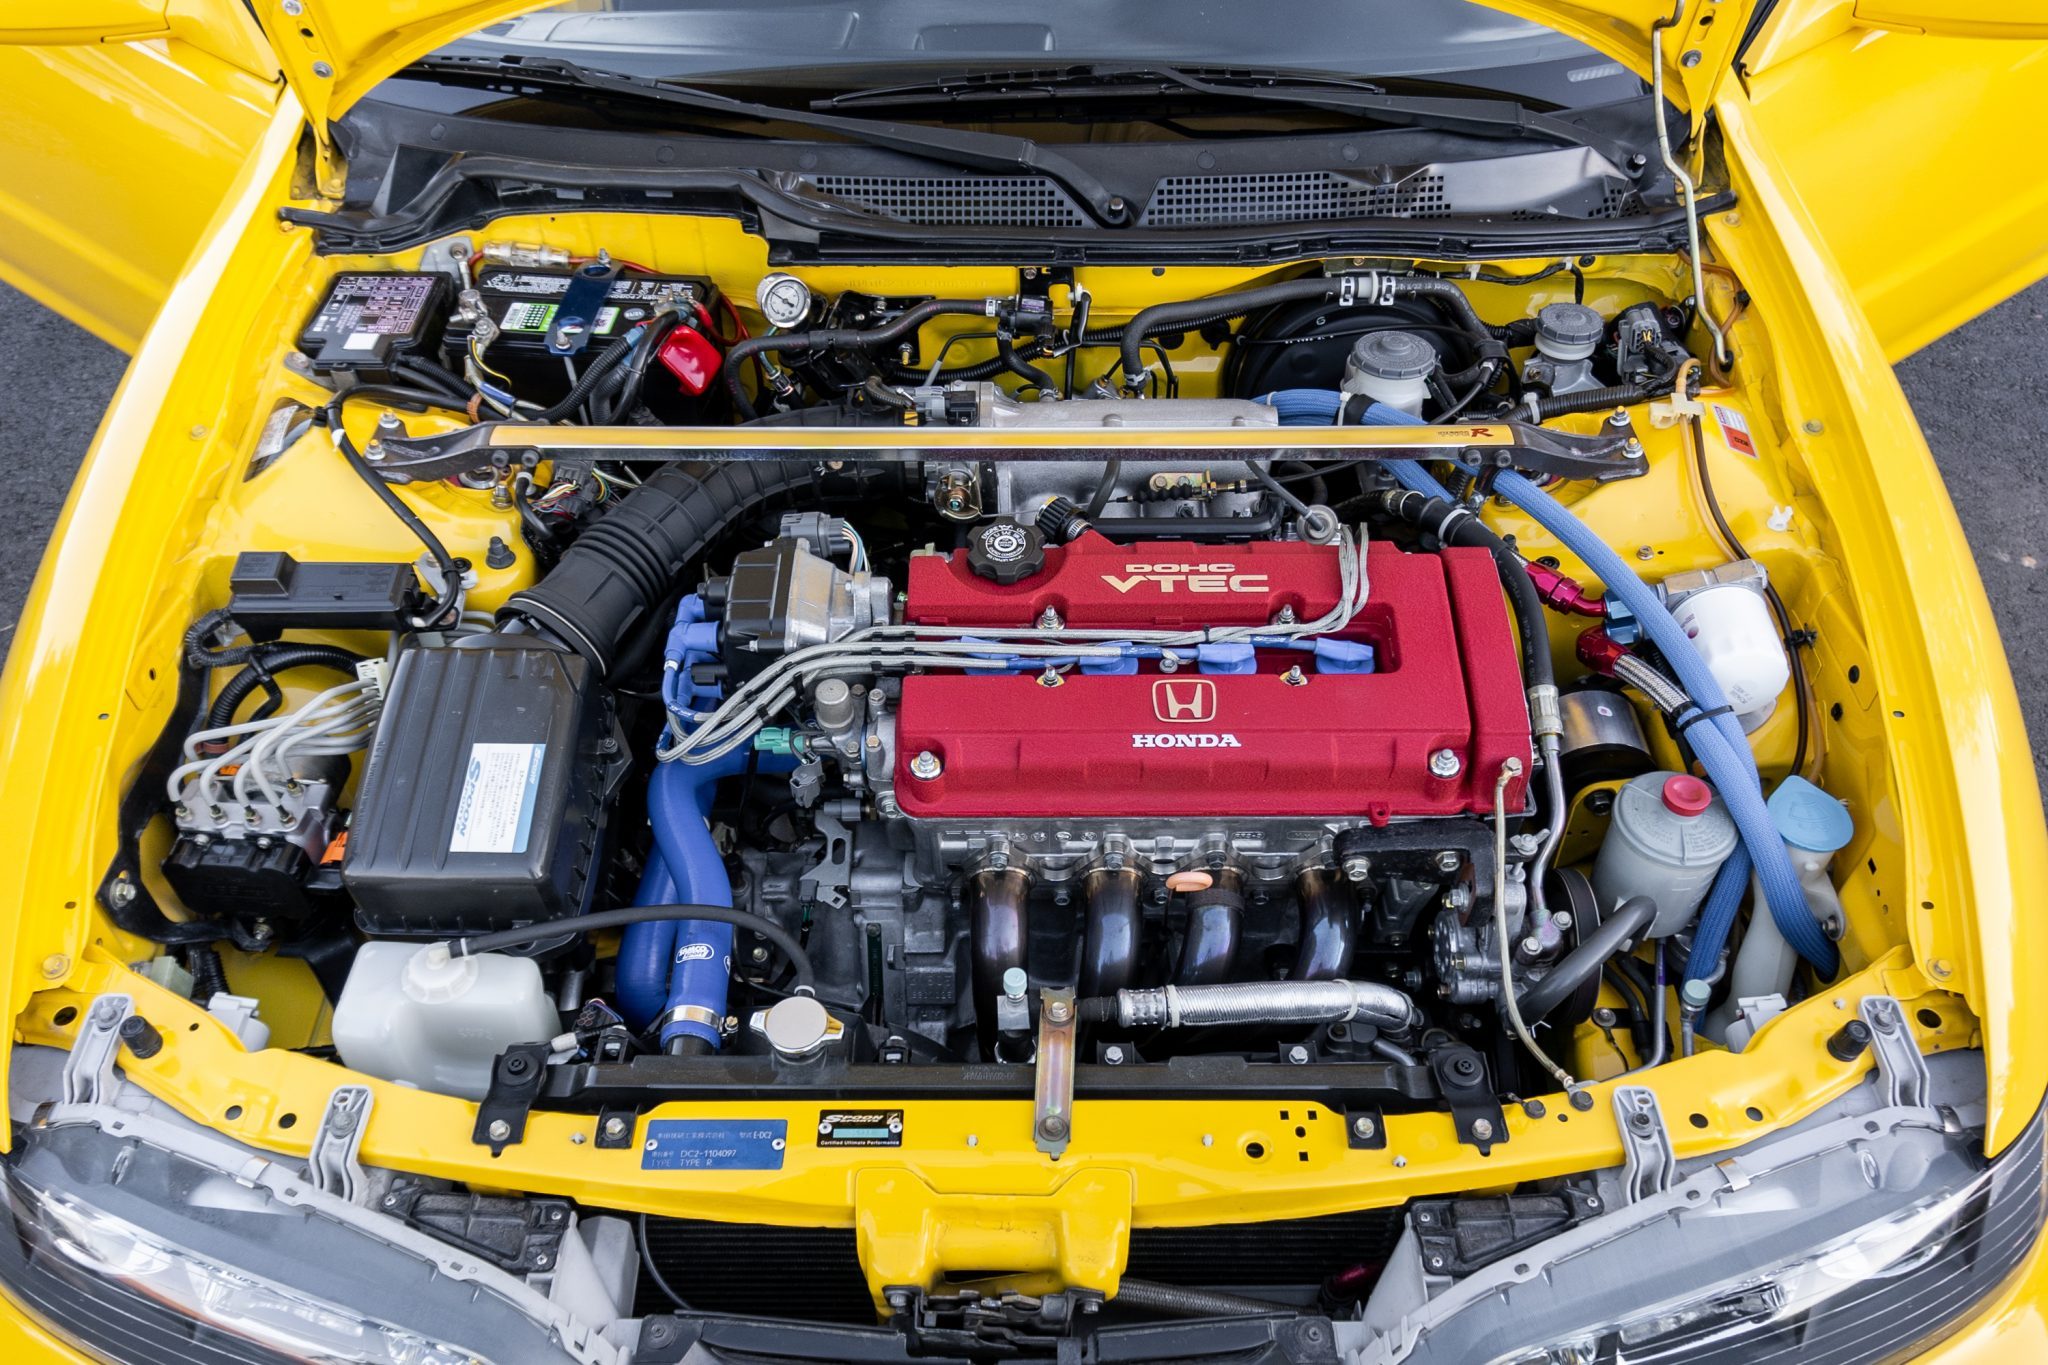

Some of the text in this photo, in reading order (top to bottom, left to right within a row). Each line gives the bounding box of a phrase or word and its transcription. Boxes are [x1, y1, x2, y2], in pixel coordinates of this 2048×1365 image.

[1125, 563, 1236, 573] DOHC
[1100, 574, 1270, 594] VTEC
[1132, 733, 1242, 748] HONDA
[459, 757, 481, 837] SPOON
[753, 1131, 773, 1139] E-DC2
[680, 1150, 737, 1158] DC2-1104097
[680, 1159, 700, 1167] TYPE
[706, 1159, 712, 1167] R
